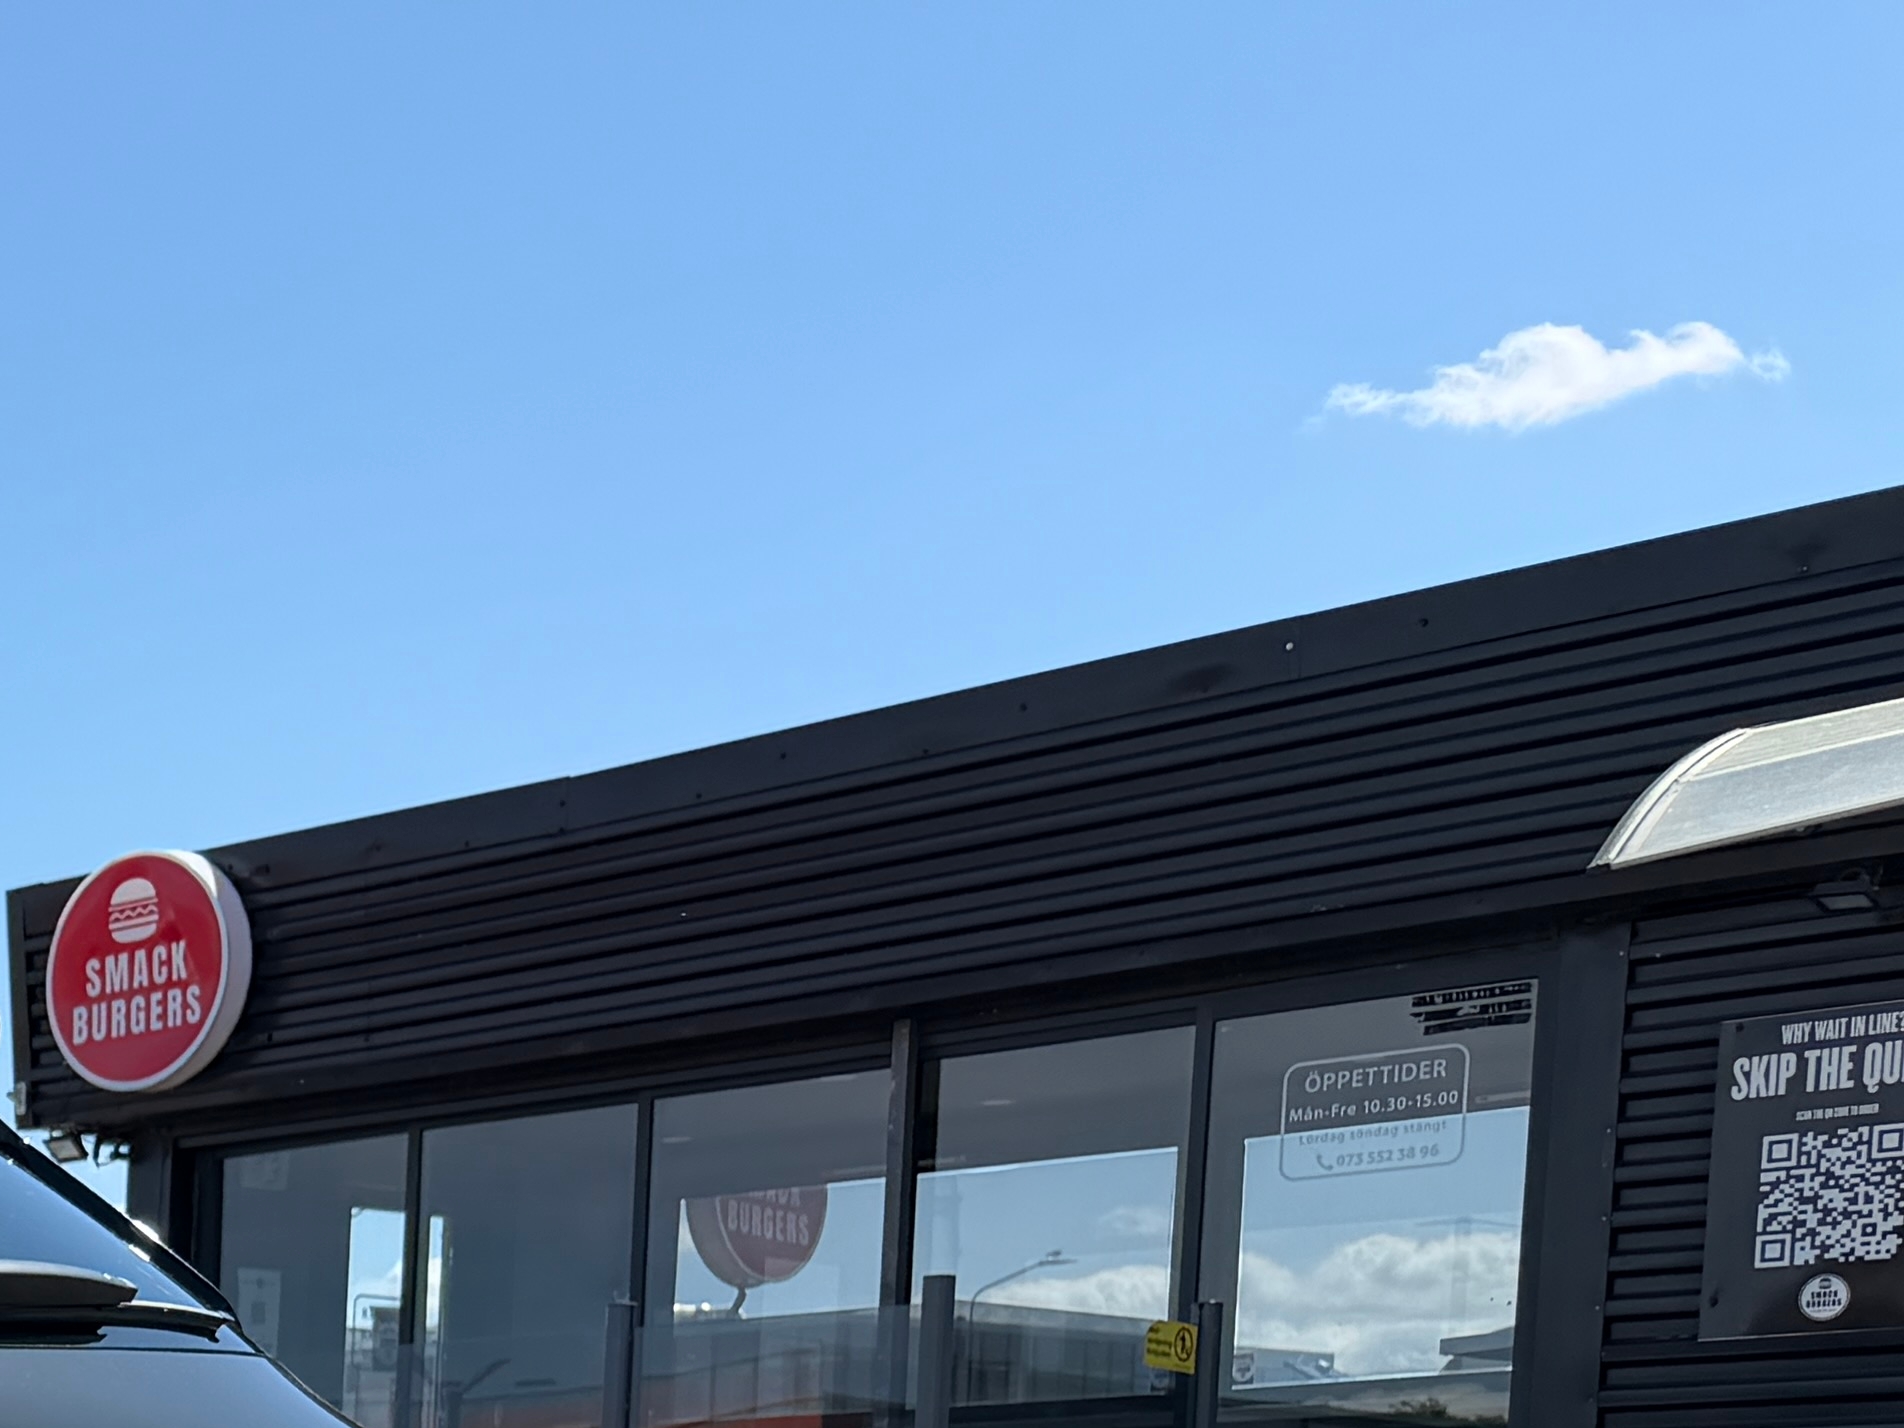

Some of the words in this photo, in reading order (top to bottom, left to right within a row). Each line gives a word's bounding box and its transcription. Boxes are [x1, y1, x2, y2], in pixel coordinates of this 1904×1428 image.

[85, 939, 188, 998] SMACK
[72, 984, 201, 1047] BURGERS
[1781, 1021, 1813, 1045] WHY
[1814, 1017, 1849, 1041] WAIT
[1850, 1015, 1867, 1038] IN
[1304, 1058, 1448, 1093] ÖPPETTIDER
[1730, 1052, 1797, 1101] SKIP
[1804, 1044, 1858, 1092] THE
[1362, 1090, 1459, 1114] 10.30-15.00
[1349, 1121, 1399, 1142] söndag
[727, 1199, 810, 1246] BURGERS
